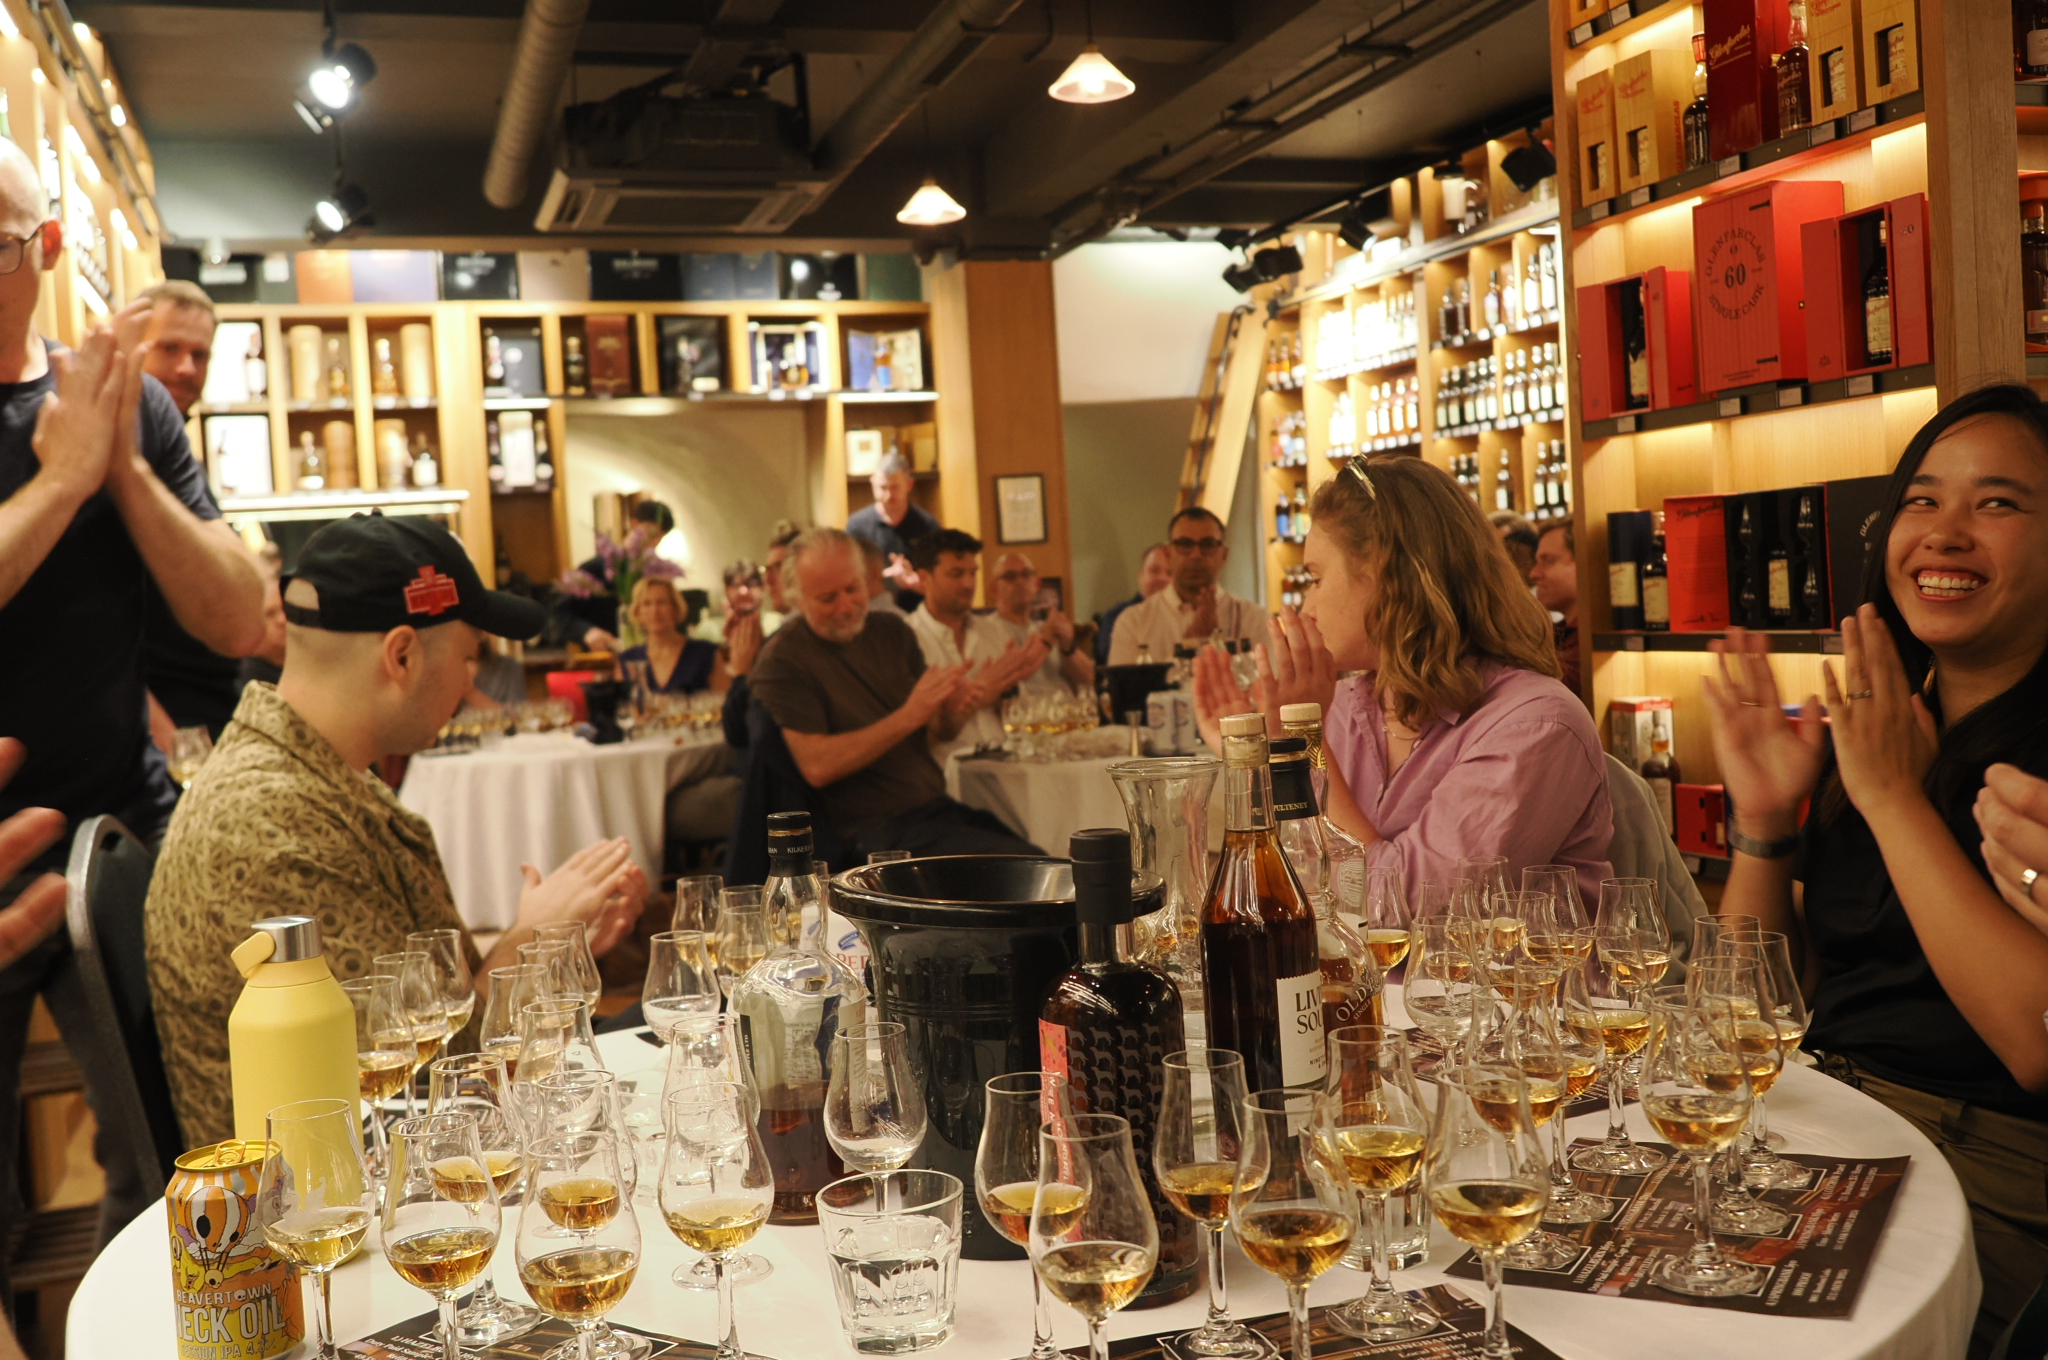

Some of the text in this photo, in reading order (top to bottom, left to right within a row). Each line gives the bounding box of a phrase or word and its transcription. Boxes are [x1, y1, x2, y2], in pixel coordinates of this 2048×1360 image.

[1706, 228, 1765, 277] GLENFARCLAS
[1725, 263, 1746, 289] 60
[1709, 284, 1764, 320] SINGLE CASK
[1336, 986, 1367, 1022] OLD
[178, 1282, 272, 1305] BEAVERTOWN
[240, 1296, 286, 1339] OIL
[182, 1343, 216, 1360] SESSION
[221, 1344, 241, 1358] IPA
[365, 1339, 385, 1347] Duty
[385, 1343, 402, 1352] Paid
[1370, 1335, 1462, 1355] SPRINGBANK
[1398, 1348, 1429, 1359] Local
[1430, 1342, 1467, 1353] Barley
